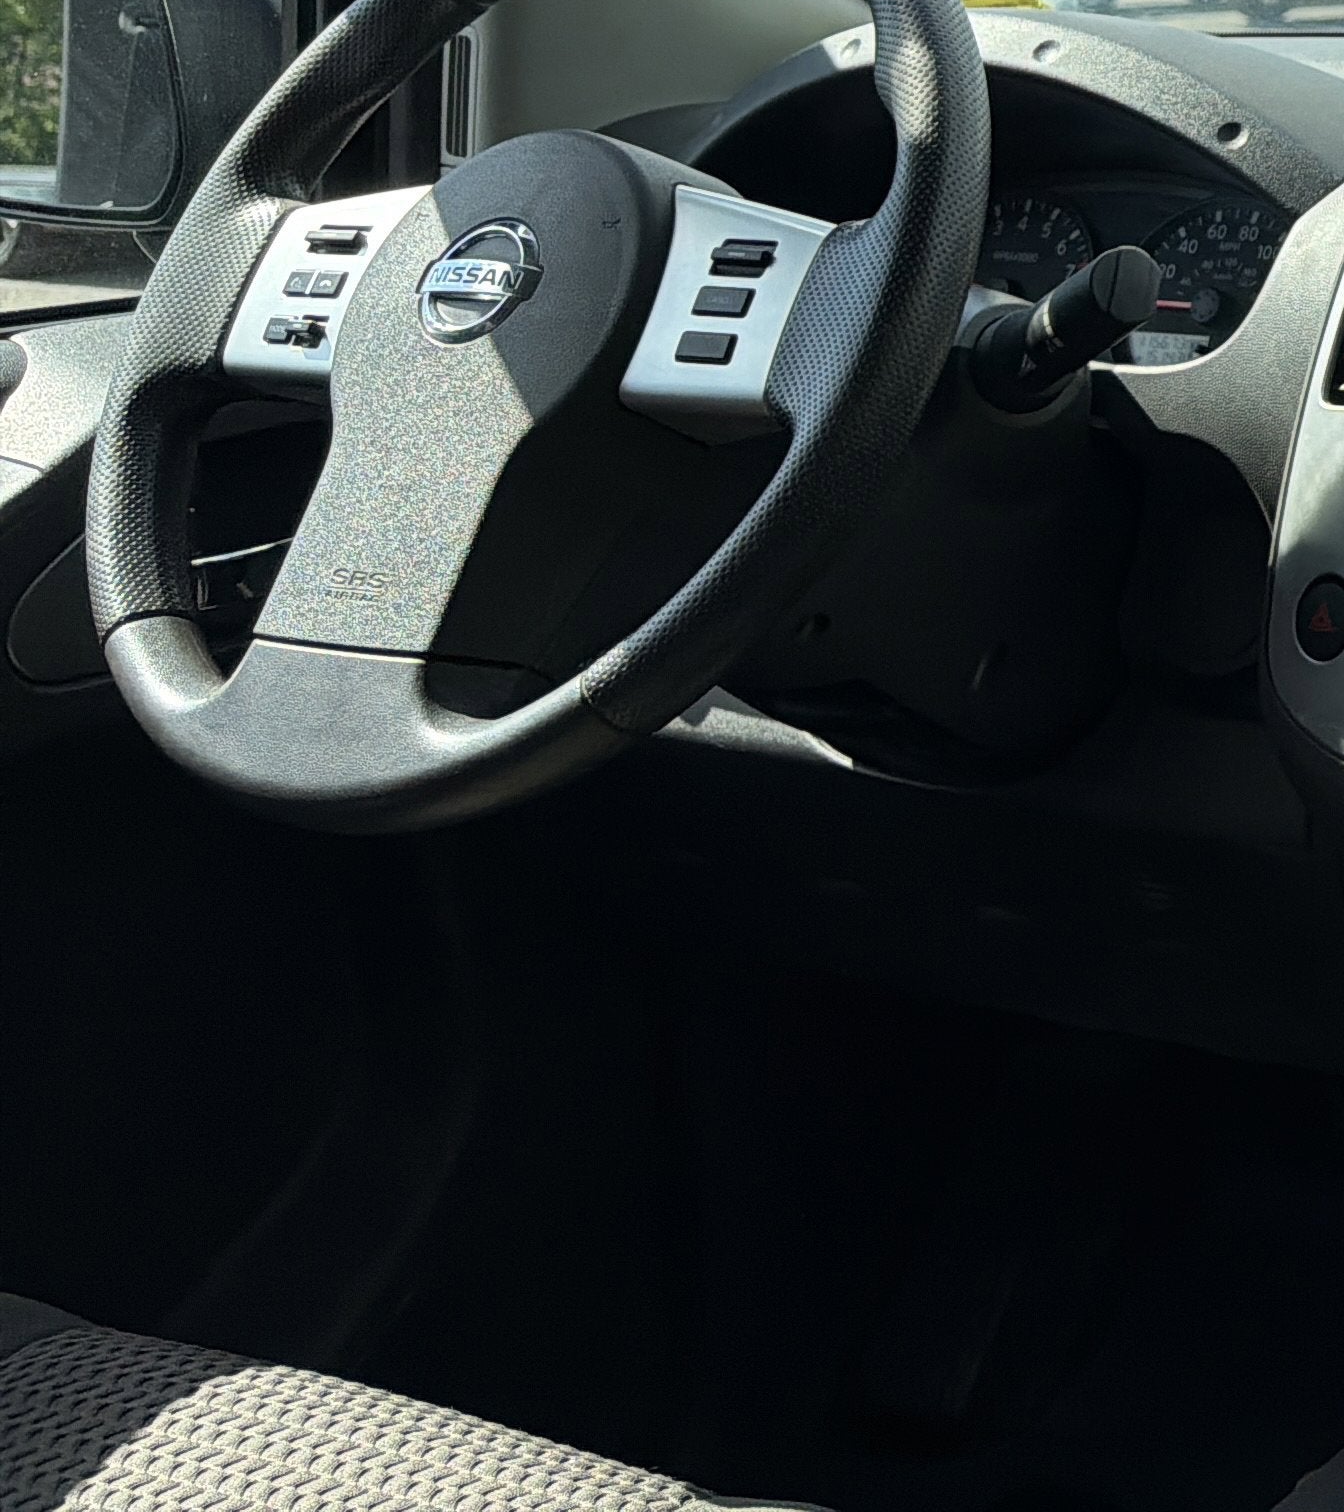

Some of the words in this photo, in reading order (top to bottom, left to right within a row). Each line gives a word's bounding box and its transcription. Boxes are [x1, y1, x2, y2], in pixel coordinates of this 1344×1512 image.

[1207, 223, 1228, 240] 60
[1240, 226, 1260, 242] 80
[1180, 239, 1199, 255] 40
[427, 266, 522, 290] NISSAN
[333, 568, 388, 588] SRS
